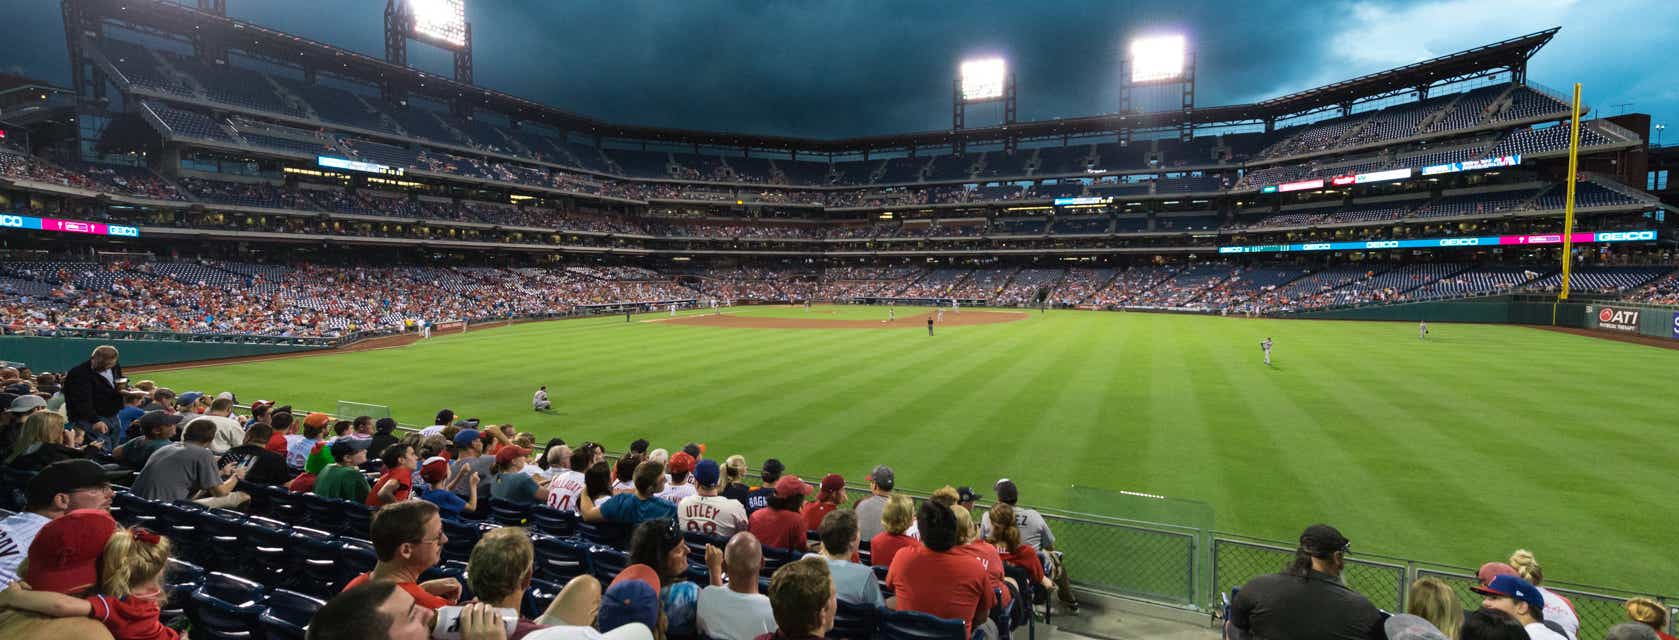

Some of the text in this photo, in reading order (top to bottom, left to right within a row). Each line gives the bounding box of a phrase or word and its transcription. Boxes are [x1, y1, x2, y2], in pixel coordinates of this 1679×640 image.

[109, 225, 137, 236] GEICO
[1599, 231, 1653, 241] GEICO
[1440, 238, 1479, 246] GEICO
[1611, 310, 1639, 325] ATI
[686, 503, 721, 520] UTLEY
